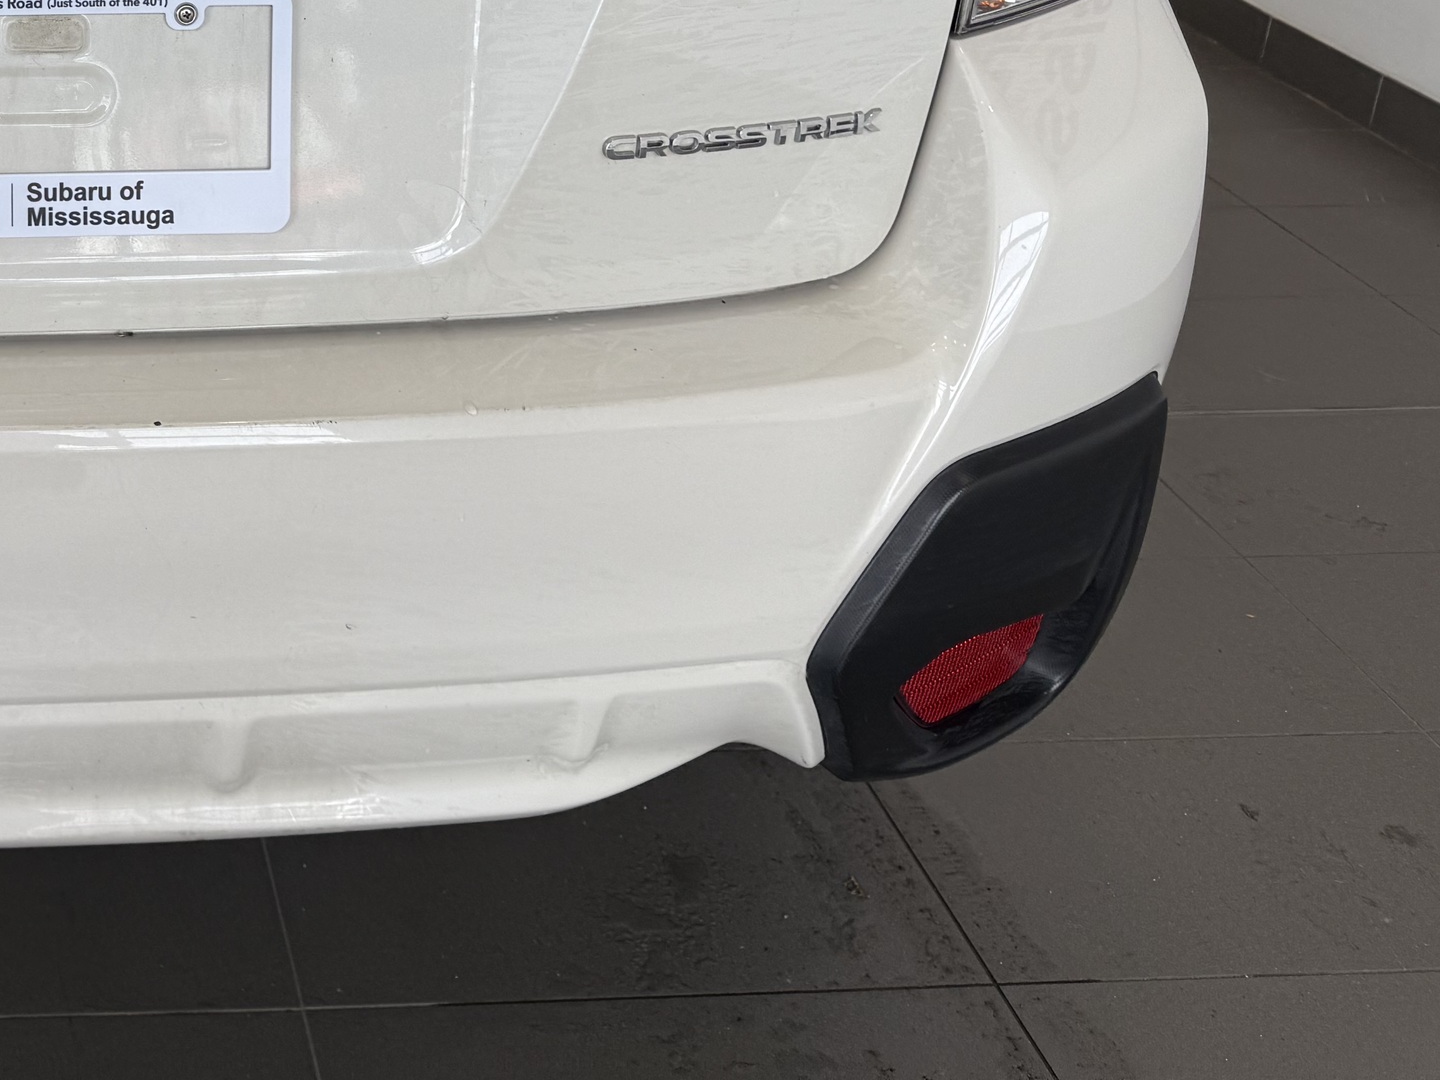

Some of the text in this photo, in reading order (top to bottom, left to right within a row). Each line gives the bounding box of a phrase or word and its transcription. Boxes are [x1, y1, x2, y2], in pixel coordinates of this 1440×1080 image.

[602, 107, 882, 160] CROSSTREK
[26, 180, 145, 202] Subaru of
[27, 206, 175, 230] Mississauga
